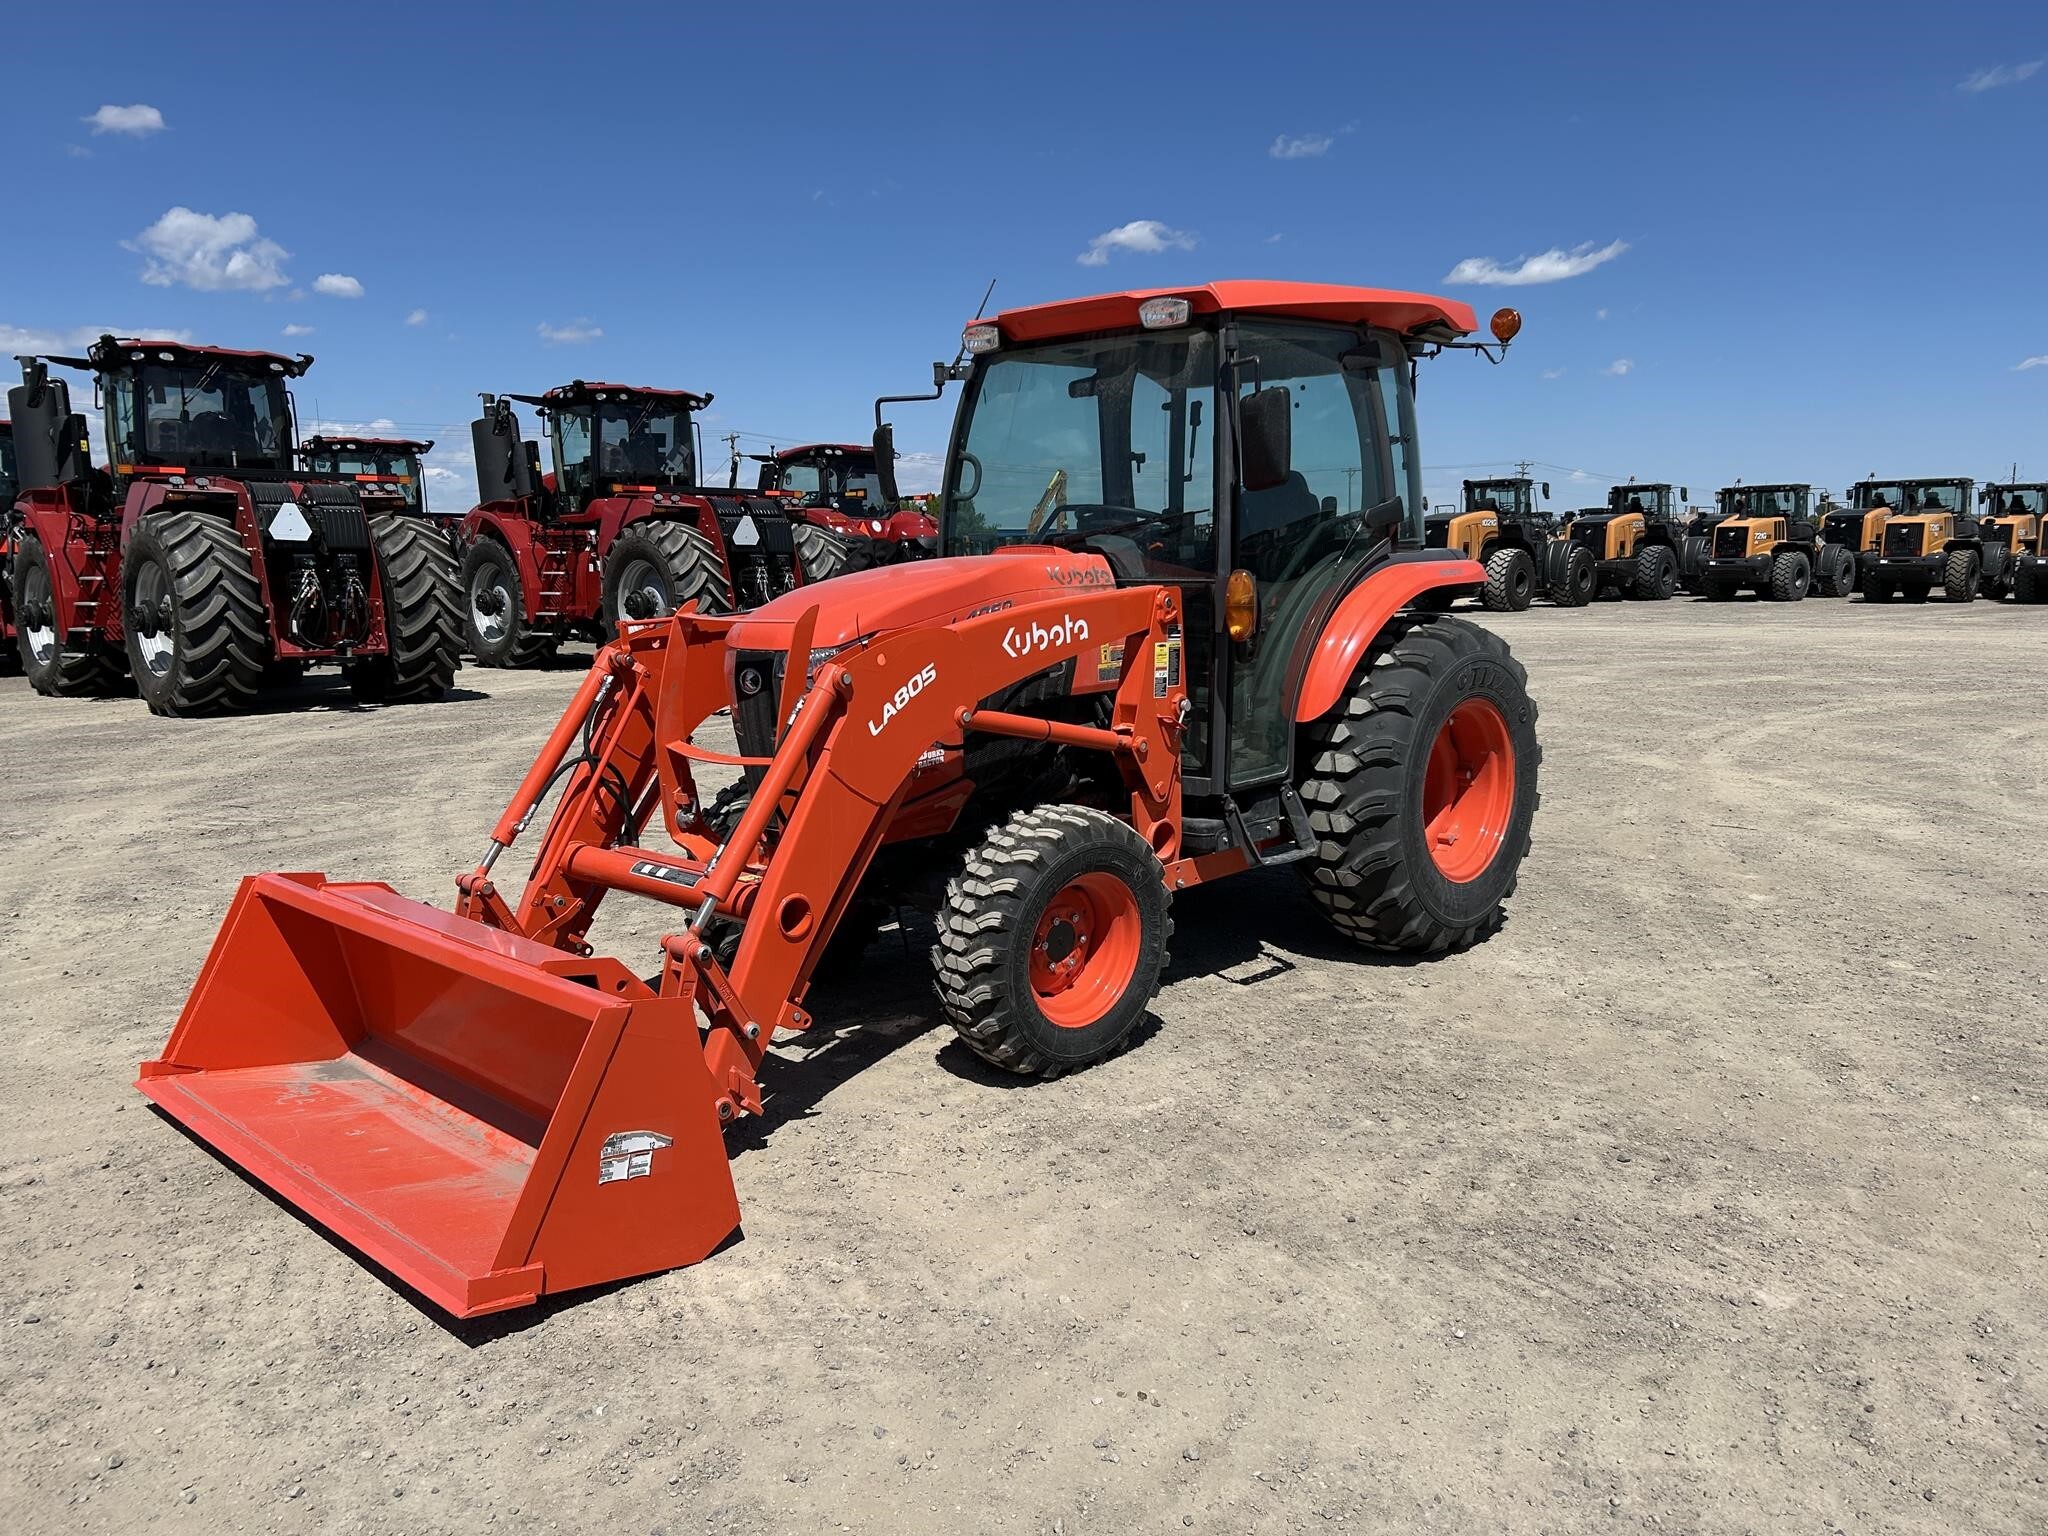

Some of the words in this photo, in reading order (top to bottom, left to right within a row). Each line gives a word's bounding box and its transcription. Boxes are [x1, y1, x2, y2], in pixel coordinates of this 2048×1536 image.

[1046, 566, 1112, 585] Kubota
[1002, 614, 1089, 658] Kubota
[868, 662, 937, 737] LA805
[915, 756, 945, 769] RACTOR
